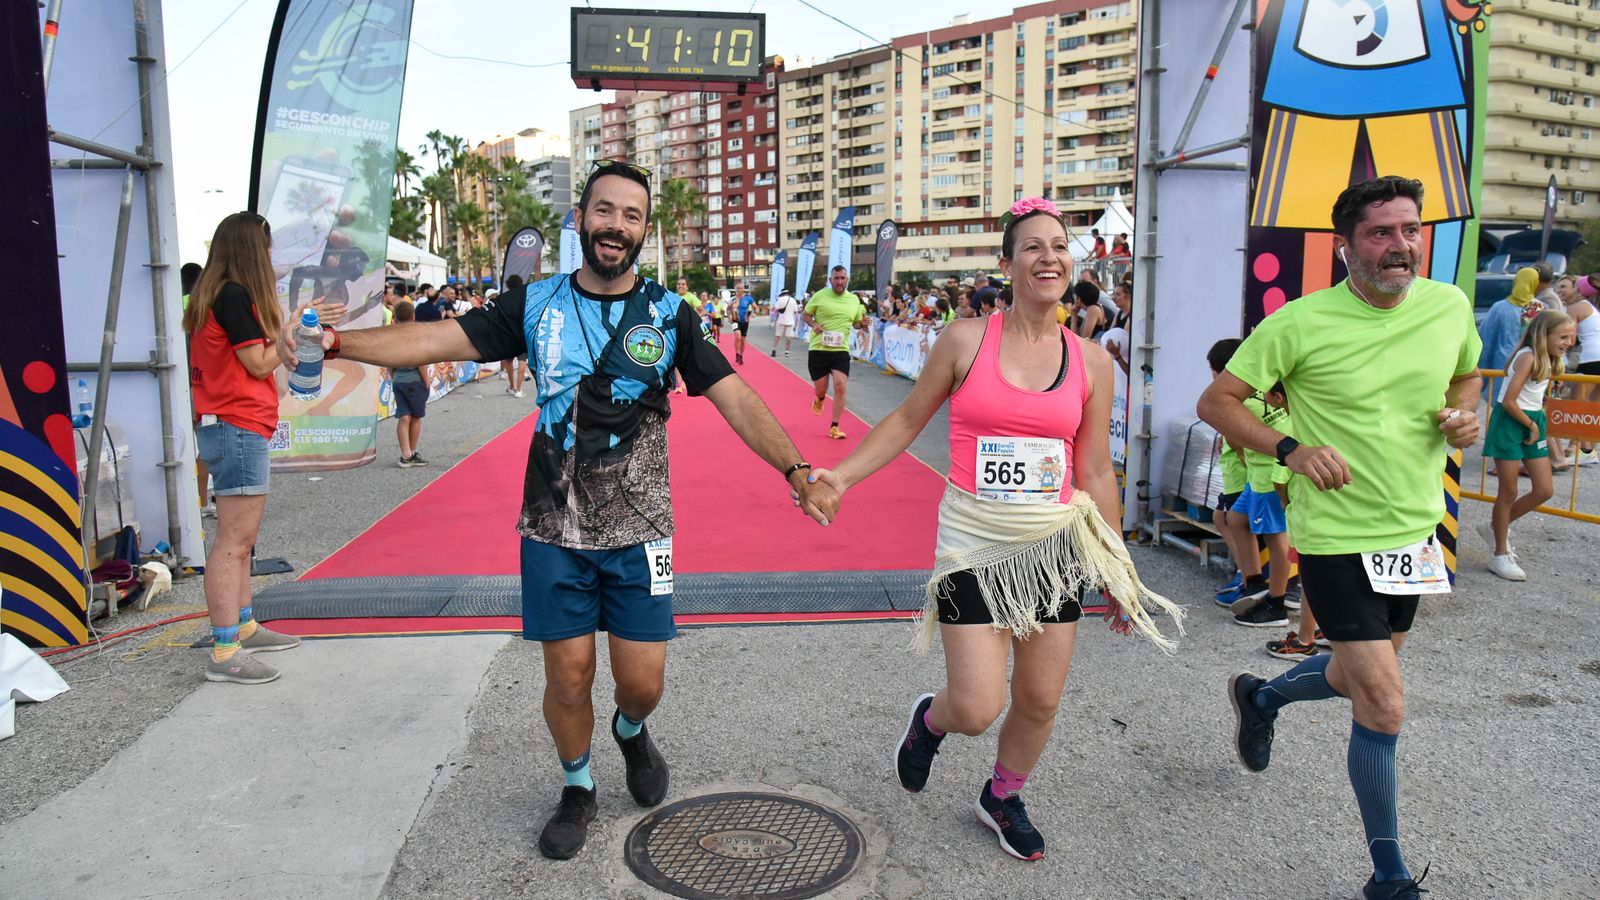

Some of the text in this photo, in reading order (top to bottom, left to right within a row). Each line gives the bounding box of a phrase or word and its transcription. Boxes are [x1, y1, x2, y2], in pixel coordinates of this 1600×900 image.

[274, 119, 389, 142] SEGUIMIENTO EN VIVO
[276, 106, 390, 132] #GESCONCHIP
[294, 427, 372, 436] GESCONCHIP.ES
[981, 443, 997, 452] XXI
[983, 461, 1026, 485] 565
[655, 554, 672, 577] 56
[1371, 553, 1412, 576] 878
